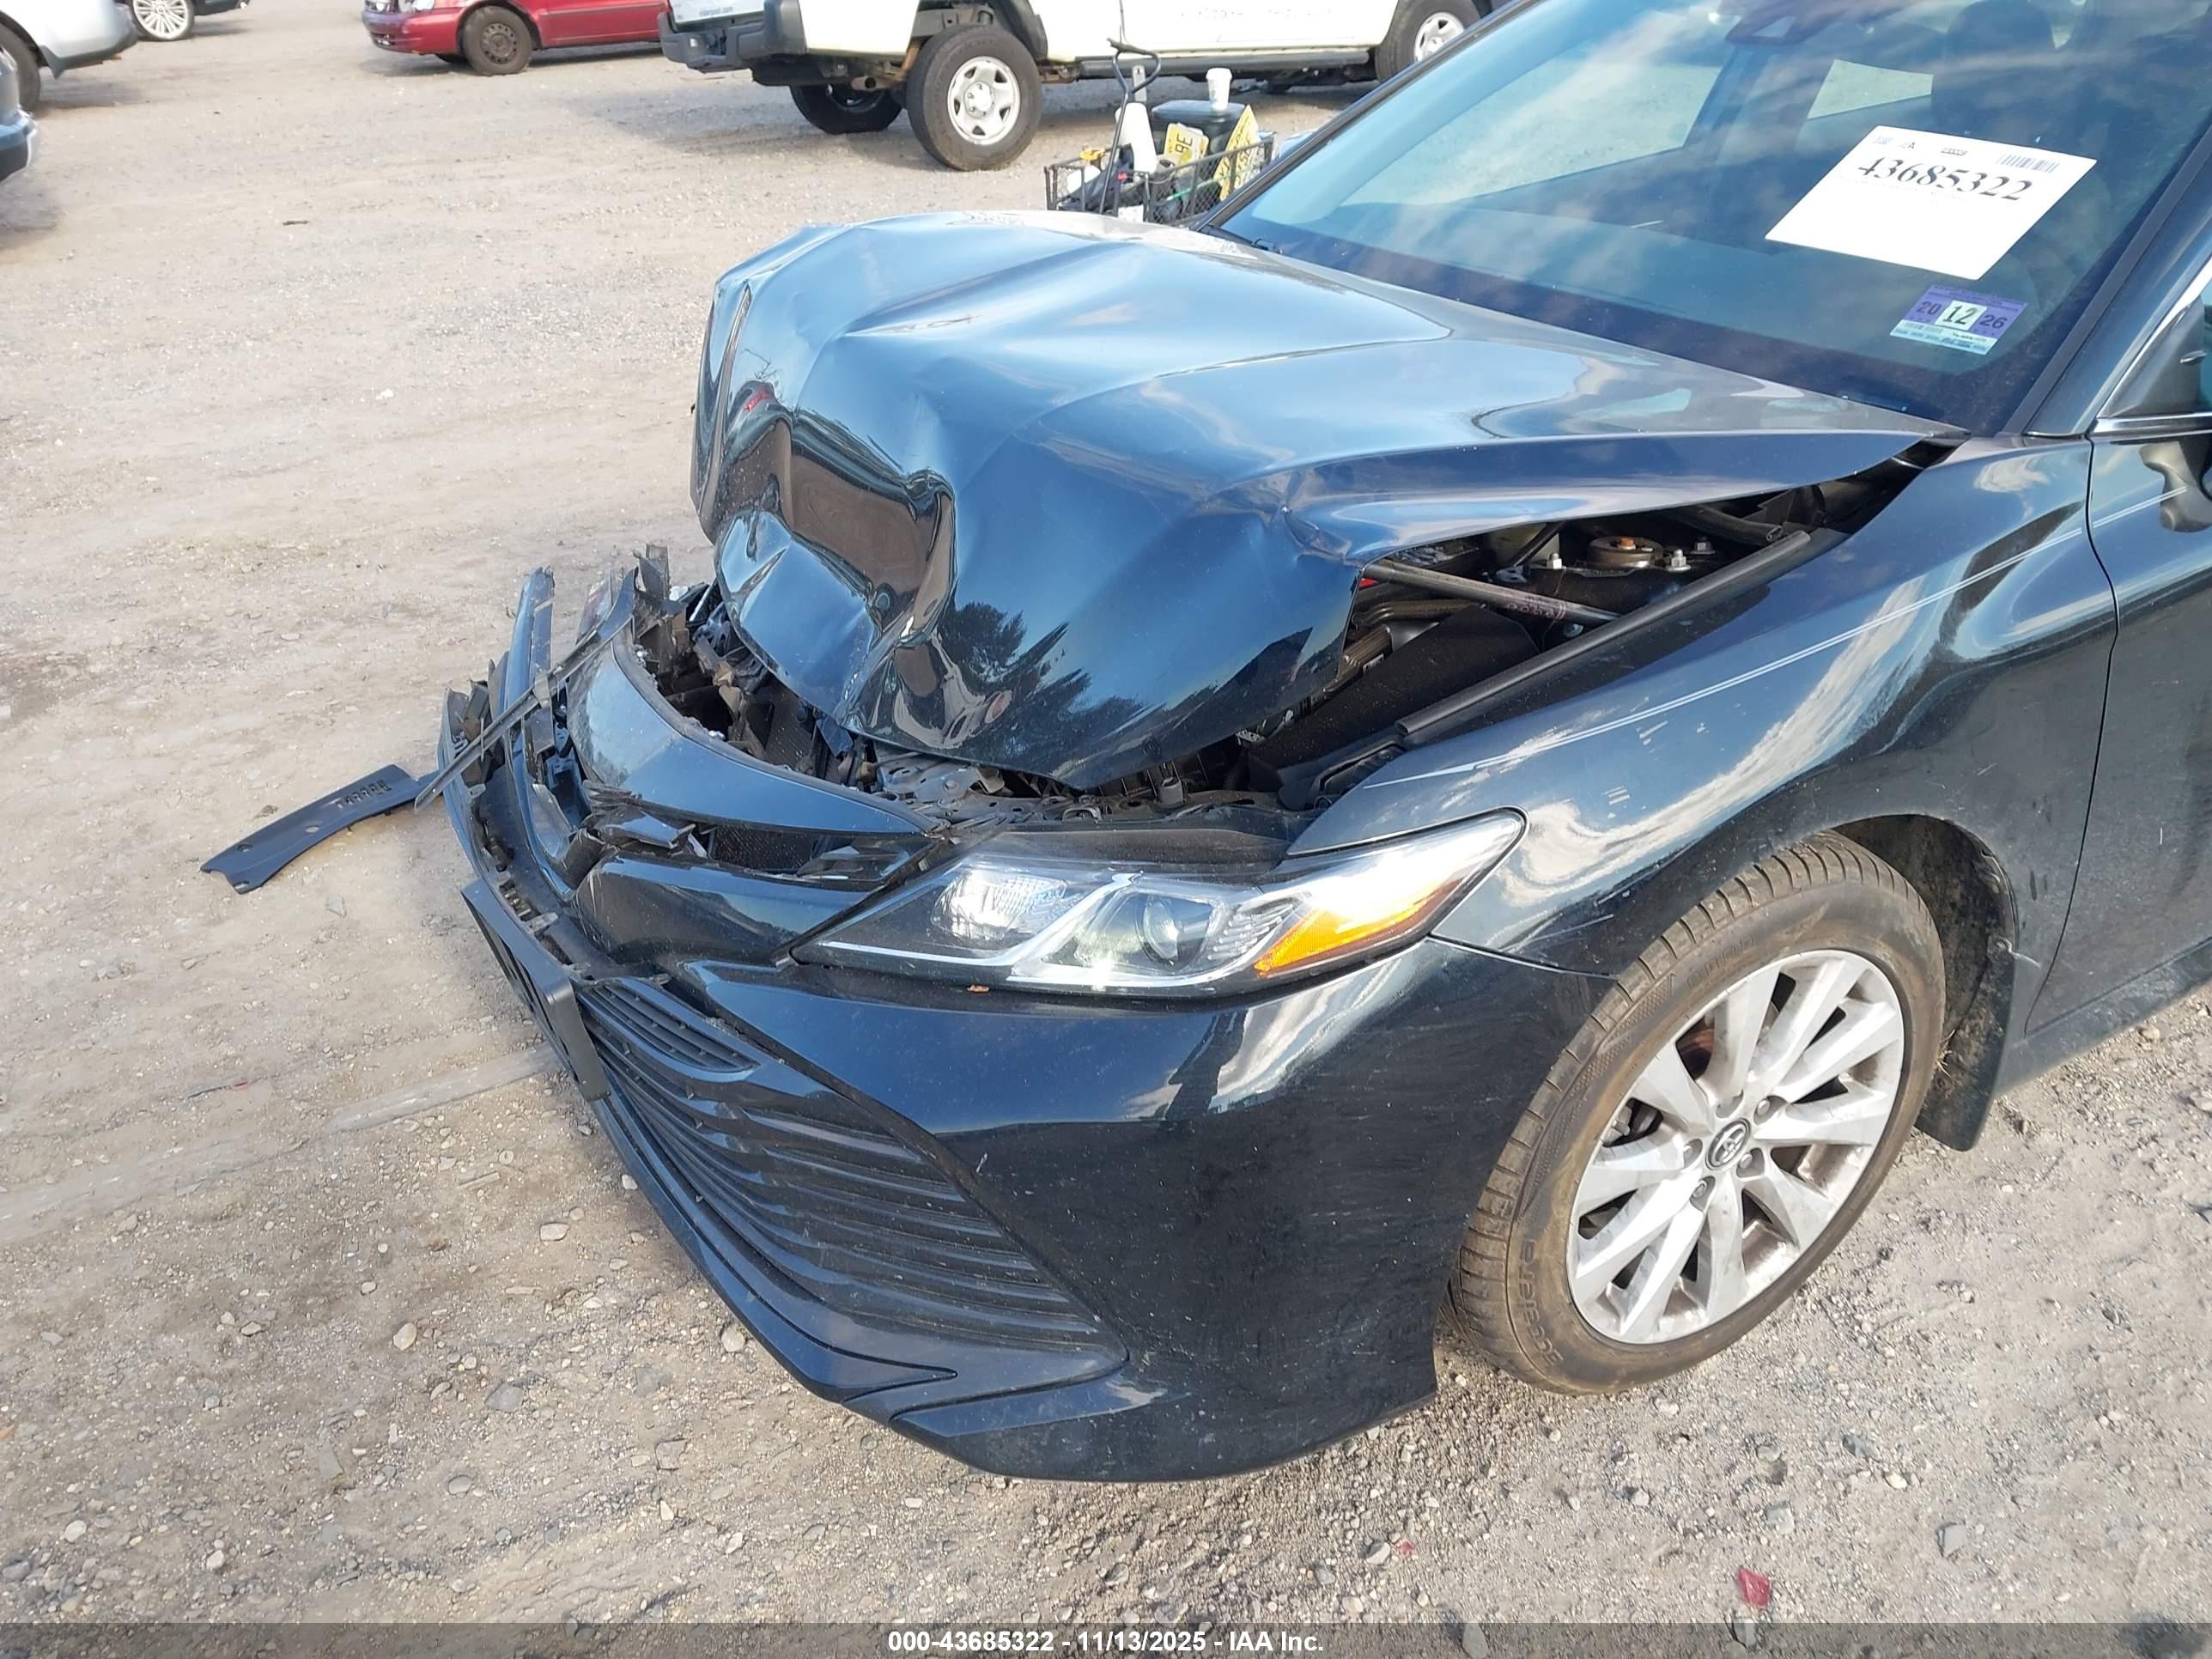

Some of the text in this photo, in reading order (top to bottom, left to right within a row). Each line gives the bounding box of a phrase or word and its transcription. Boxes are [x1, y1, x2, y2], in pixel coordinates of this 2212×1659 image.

[1857, 156, 2033, 201] 43685322
[1916, 301, 2008, 329] 20 12 26
